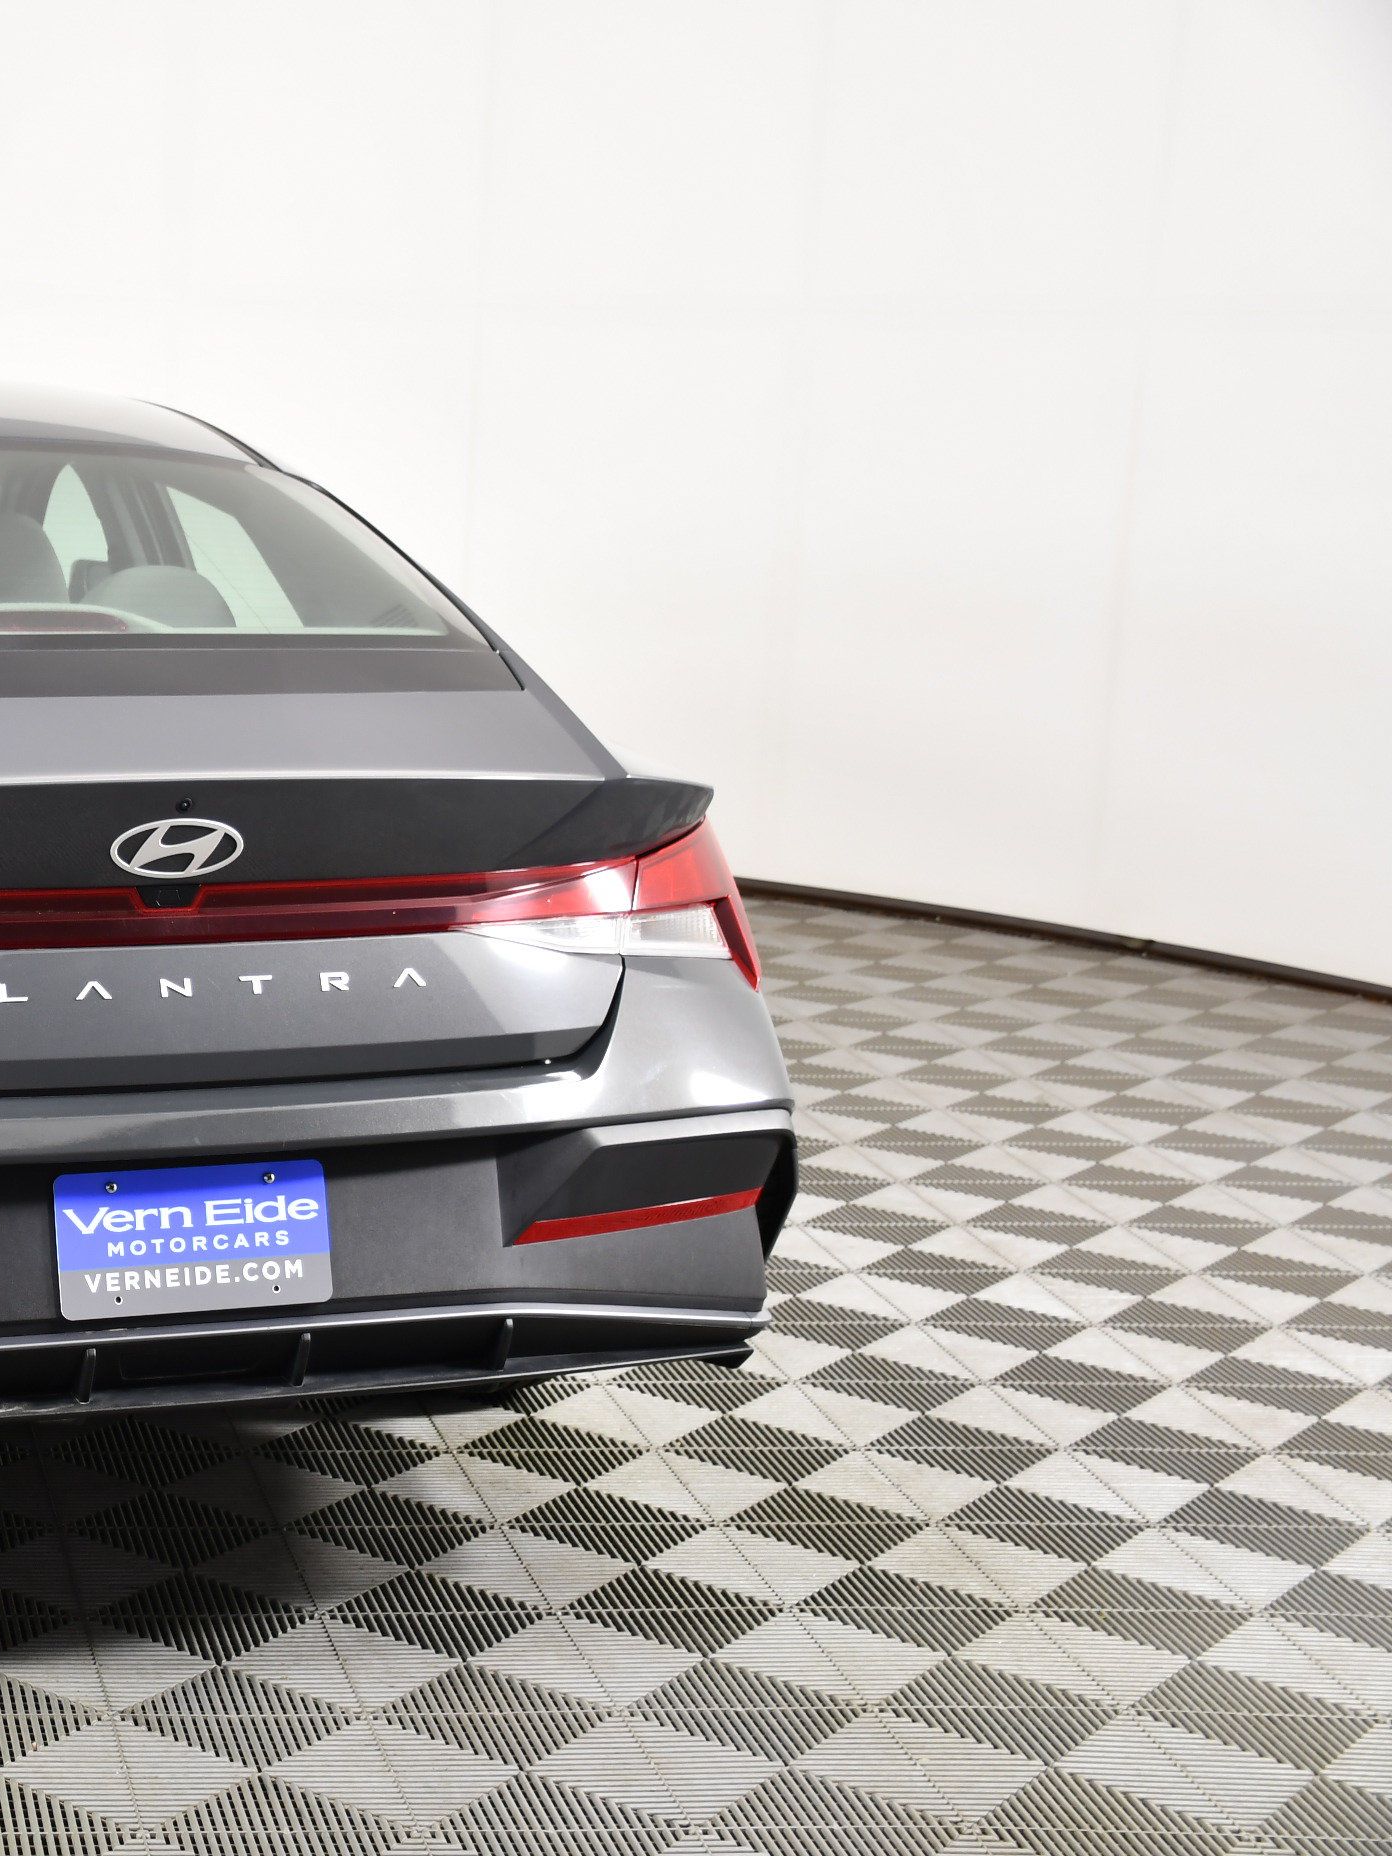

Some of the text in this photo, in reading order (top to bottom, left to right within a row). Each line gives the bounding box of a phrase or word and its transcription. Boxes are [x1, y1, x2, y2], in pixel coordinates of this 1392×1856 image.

[63, 1195, 319, 1234] Vern Eide
[107, 1230, 290, 1257] MOTORCARS
[83, 1258, 304, 1294] VERNEIDE.COM
